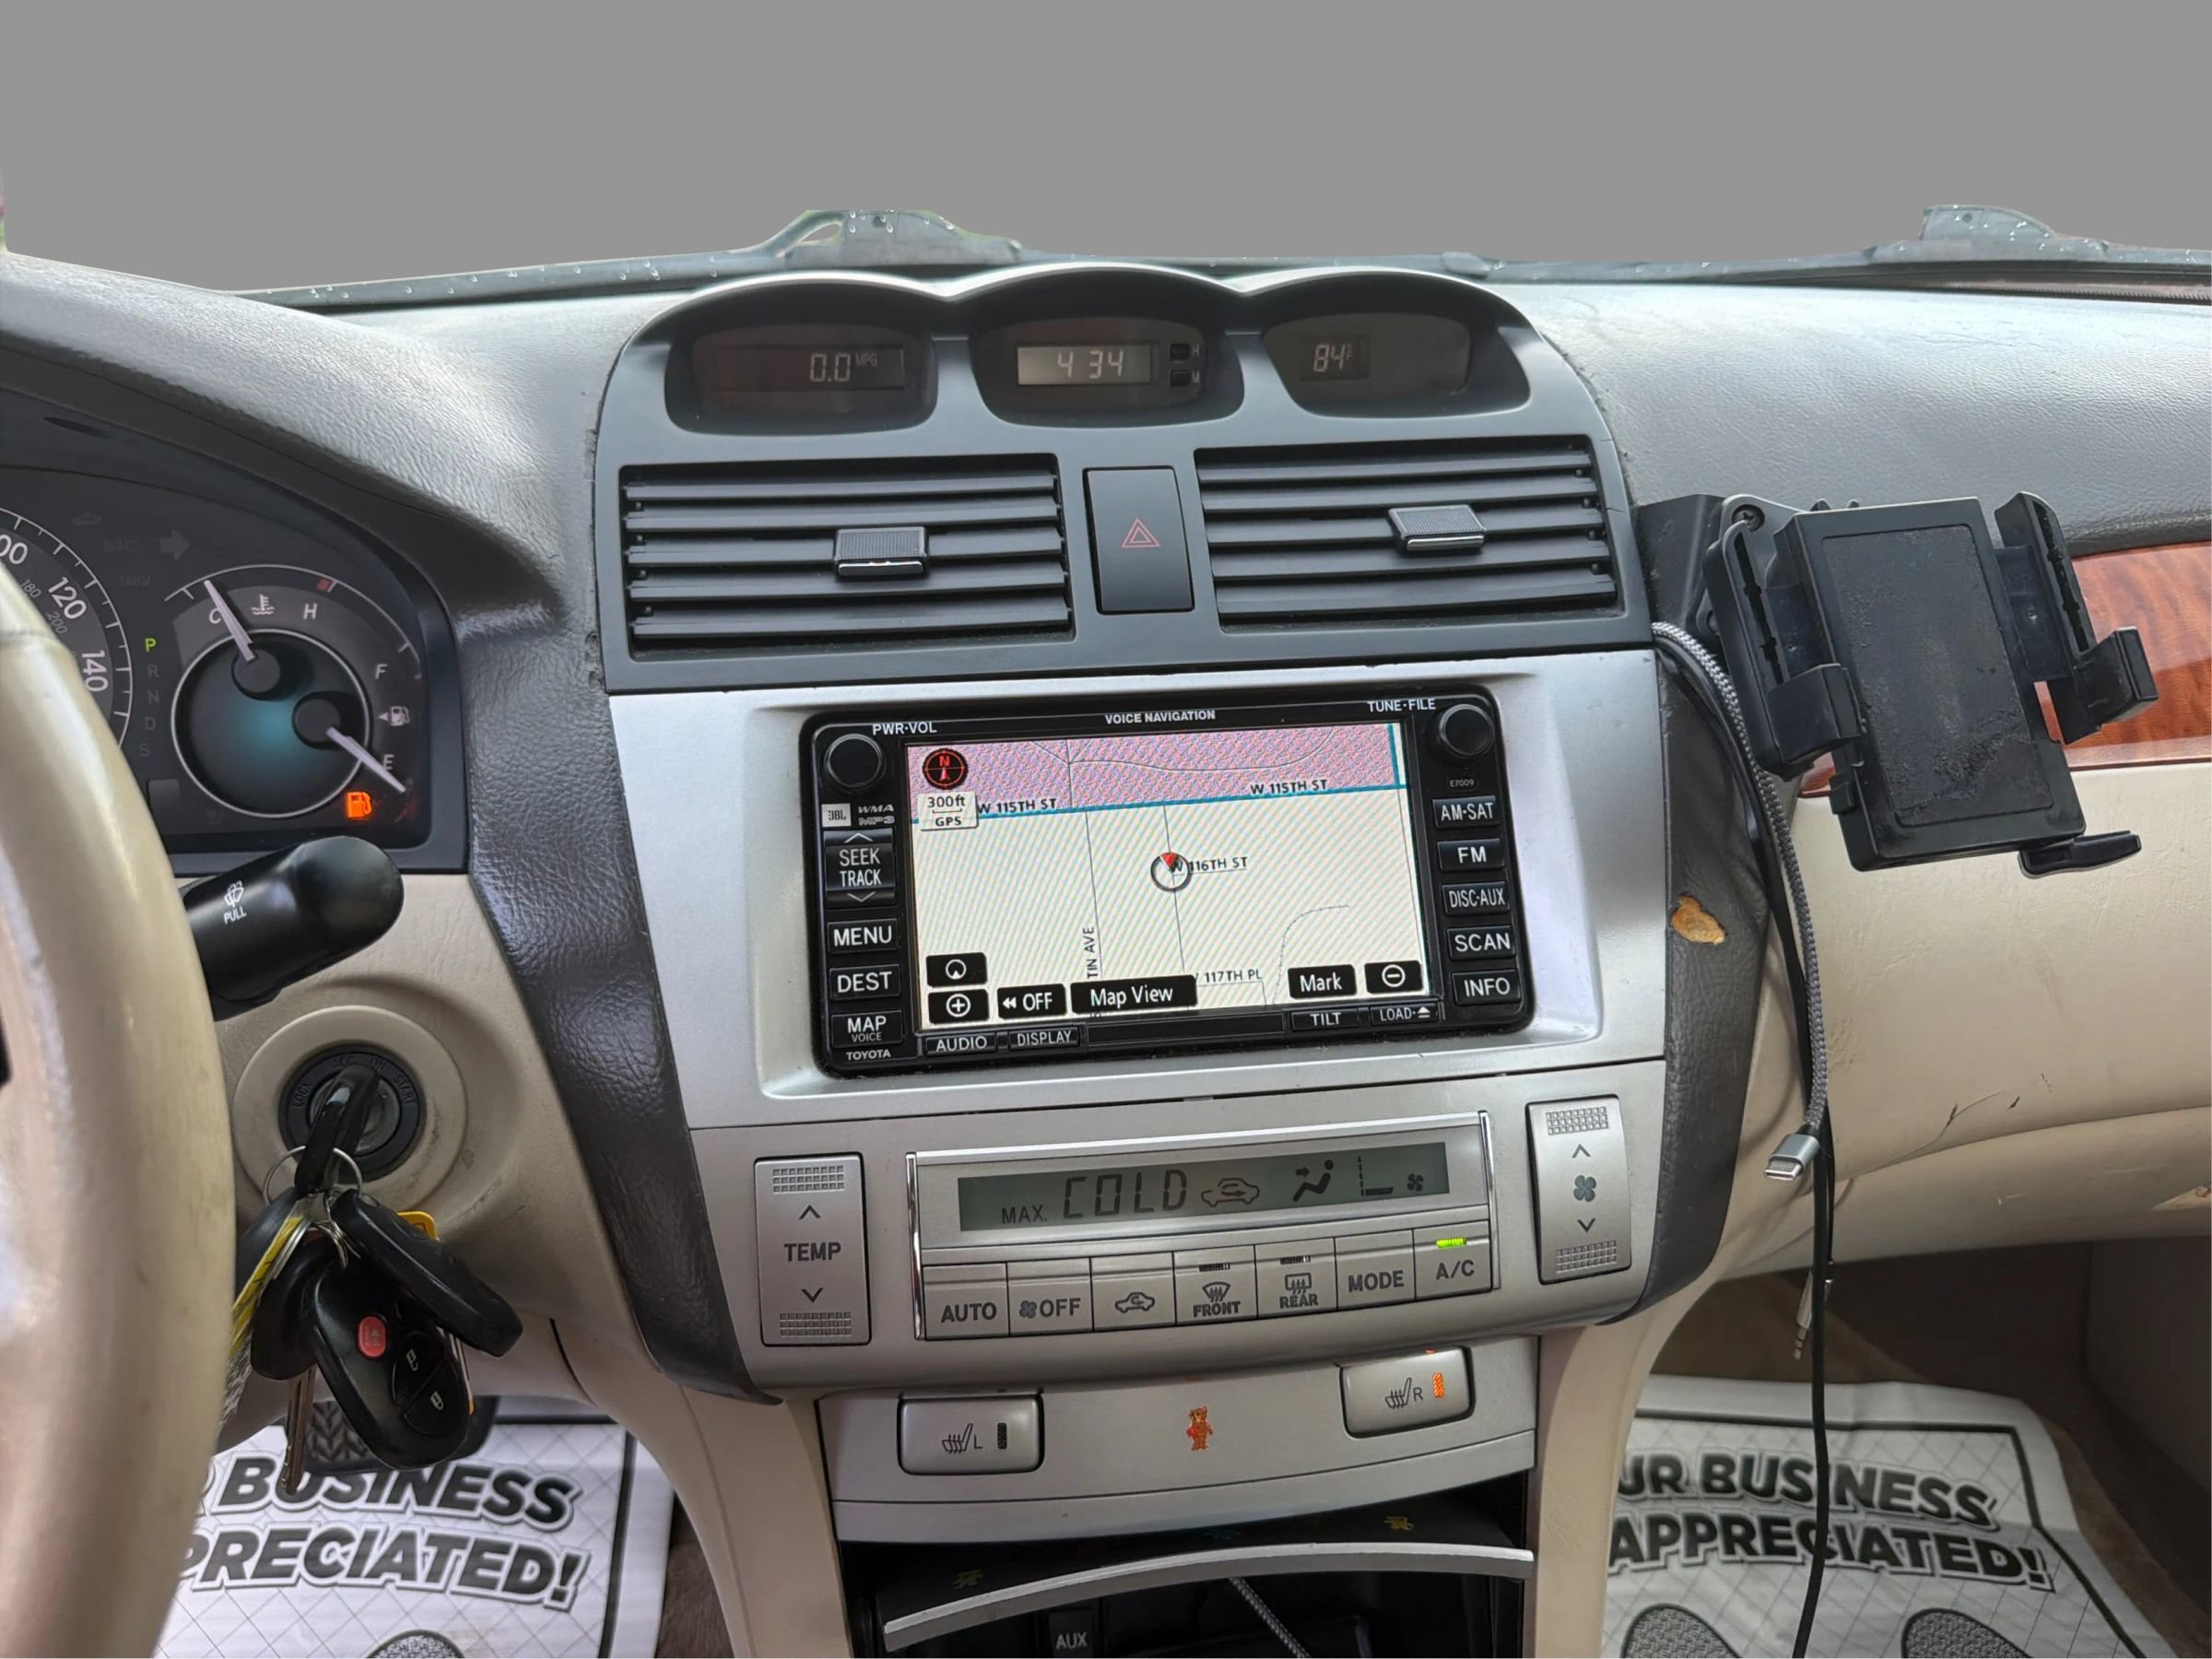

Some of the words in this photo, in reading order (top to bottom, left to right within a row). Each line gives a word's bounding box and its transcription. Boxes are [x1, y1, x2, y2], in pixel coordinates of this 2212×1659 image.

[810, 353, 852, 382] 0.0
[21, 579, 42, 599] 180
[48, 576, 88, 619] 120
[209, 607, 223, 625] C
[302, 603, 318, 620] H
[47, 611, 68, 635] 200
[145, 638, 157, 653] P
[82, 649, 109, 692] 140
[147, 664, 160, 678] R
[375, 664, 389, 679] F
[147, 689, 160, 704] N
[145, 716, 156, 731] D
[1105, 712, 1143, 725] VOICE
[1144, 710, 1217, 724] NAVIGATION
[139, 743, 150, 758] S
[382, 754, 395, 771] E
[939, 756, 950, 767] N
[1251, 783, 1265, 794] W
[1270, 781, 1308, 794] 115TH
[1312, 780, 1328, 792] ST
[1449, 778, 1475, 789] E7009
[857, 804, 895, 814] WMA
[927, 794, 967, 809] 300ft
[978, 803, 992, 814] W
[997, 799, 1035, 813] 115TH
[1041, 798, 1057, 809] ST
[828, 809, 847, 821] JBL
[858, 815, 896, 826] MP3
[935, 816, 963, 827] GPS
[839, 848, 882, 867] SEEK
[1189, 858, 1227, 872] 116TH
[1231, 856, 1248, 869] ST
[1457, 846, 1488, 865] FM
[840, 868, 882, 888] TRACK
[223, 906, 248, 924] PULL
[833, 925, 893, 947] MENU
[1082, 926, 1096, 954] AVE
[1454, 933, 1512, 953] SCAN
[837, 971, 893, 994] DEST
[1206, 970, 1243, 983] 117TH
[1248, 969, 1263, 981] PL
[1300, 973, 1343, 994] Mark
[1464, 977, 1511, 997] INFO
[1022, 993, 1053, 1012] OFF
[1089, 988, 1127, 1009] Map
[1131, 984, 1174, 1004] View
[847, 1015, 887, 1034] MAP
[1310, 1012, 1342, 1027] TILT
[851, 1031, 883, 1043] VOICE
[935, 1036, 988, 1053] AUDIO
[1017, 1030, 1073, 1047] DISPLAY
[846, 1049, 892, 1062] TOYOTA
[1062, 1168, 1188, 1219] COLD
[783, 1241, 842, 1262] TEMP
[1436, 1259, 1476, 1280] A/C
[1347, 1269, 1405, 1293] MODE
[1040, 1298, 1082, 1317] OFF
[1193, 1300, 1241, 1318] FRONT
[1279, 1294, 1319, 1309] REAR
[940, 1301, 997, 1323] AUTO
[1413, 1386, 1423, 1402] R
[973, 1436, 983, 1450] L
[1700, 1452, 1994, 1530] BUSNESS
[1055, 1630, 1088, 1650] AUX
